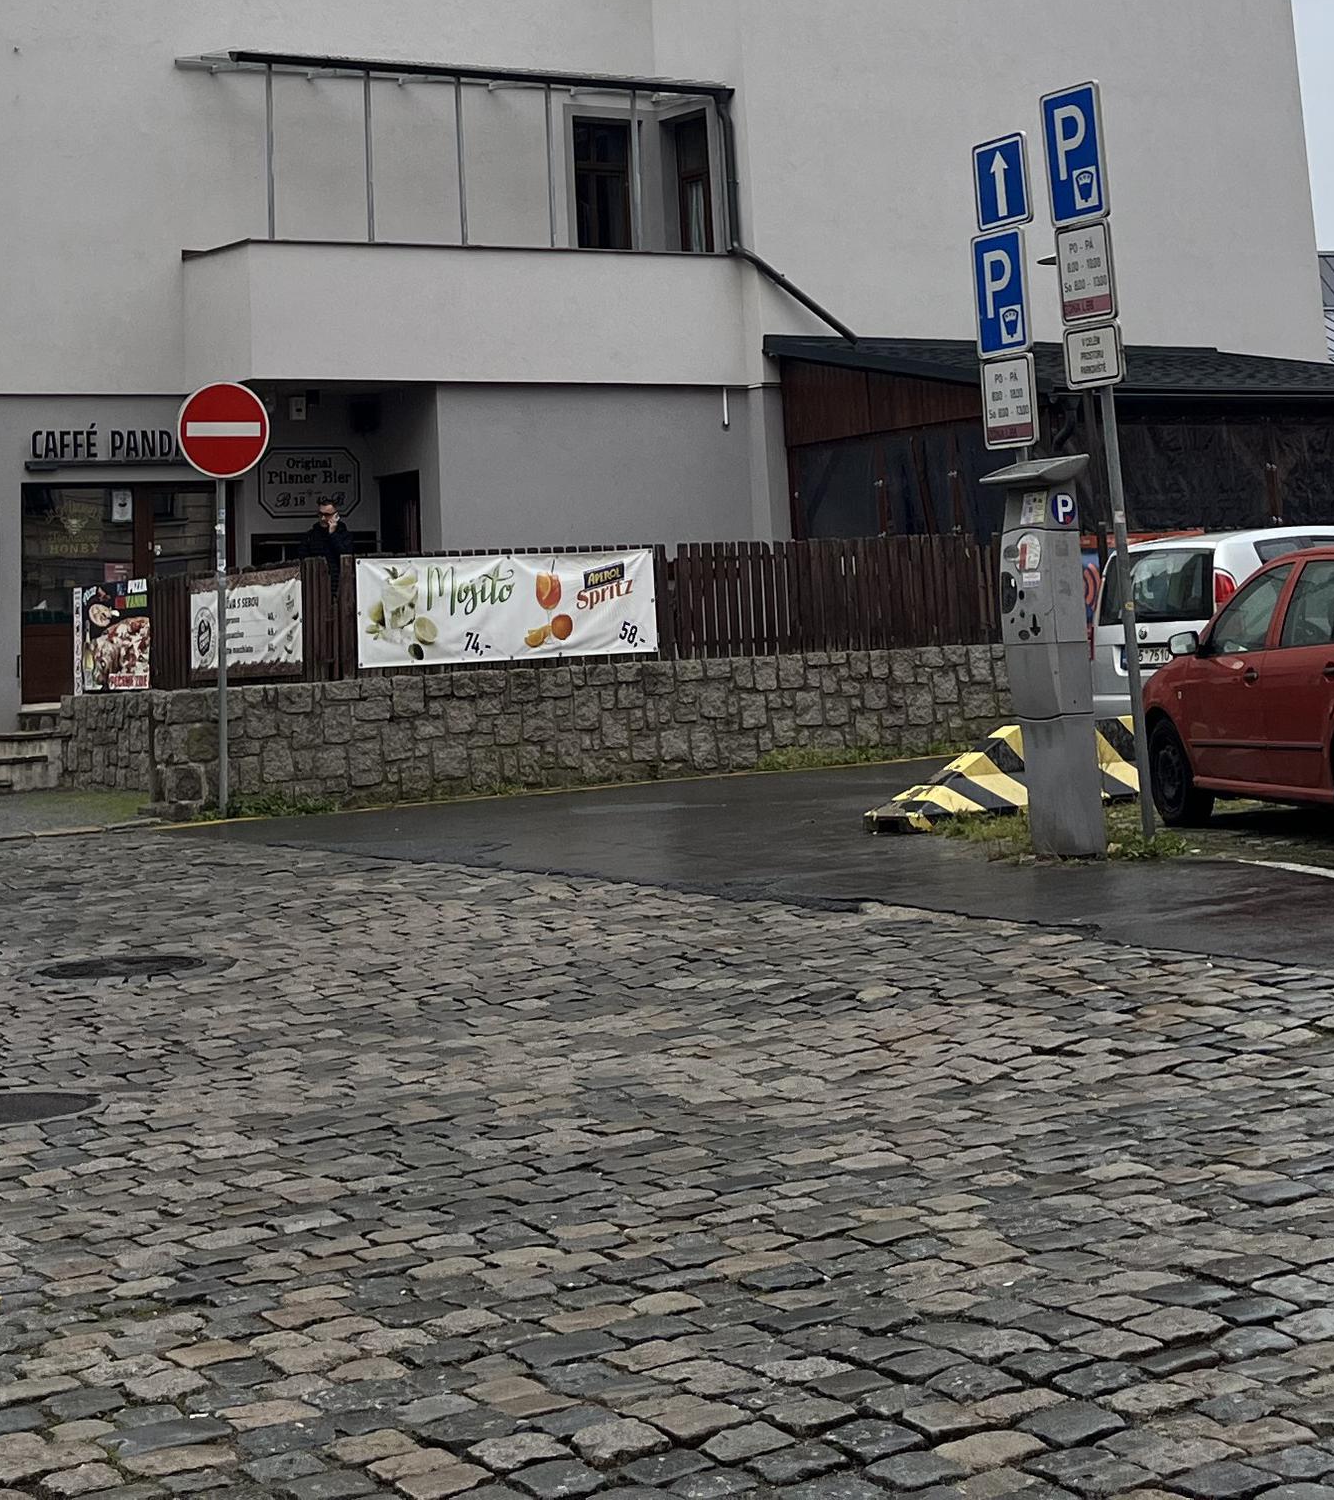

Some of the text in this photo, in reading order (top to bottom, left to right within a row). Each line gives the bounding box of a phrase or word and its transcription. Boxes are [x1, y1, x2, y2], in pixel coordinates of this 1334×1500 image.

[1053, 103, 1087, 181] P
[982, 249, 1012, 319] P
[31, 422, 98, 459] CAFFÉ
[267, 470, 352, 484] Pilsner Bier
[286, 457, 332, 470] Original
[1057, 494, 1073, 523] P
[425, 564, 515, 617] Mojito
[587, 566, 623, 586] APEROL
[576, 579, 634, 611] Spritz
[465, 632, 492, 657] 74,-
[618, 621, 646, 648] 58,-
